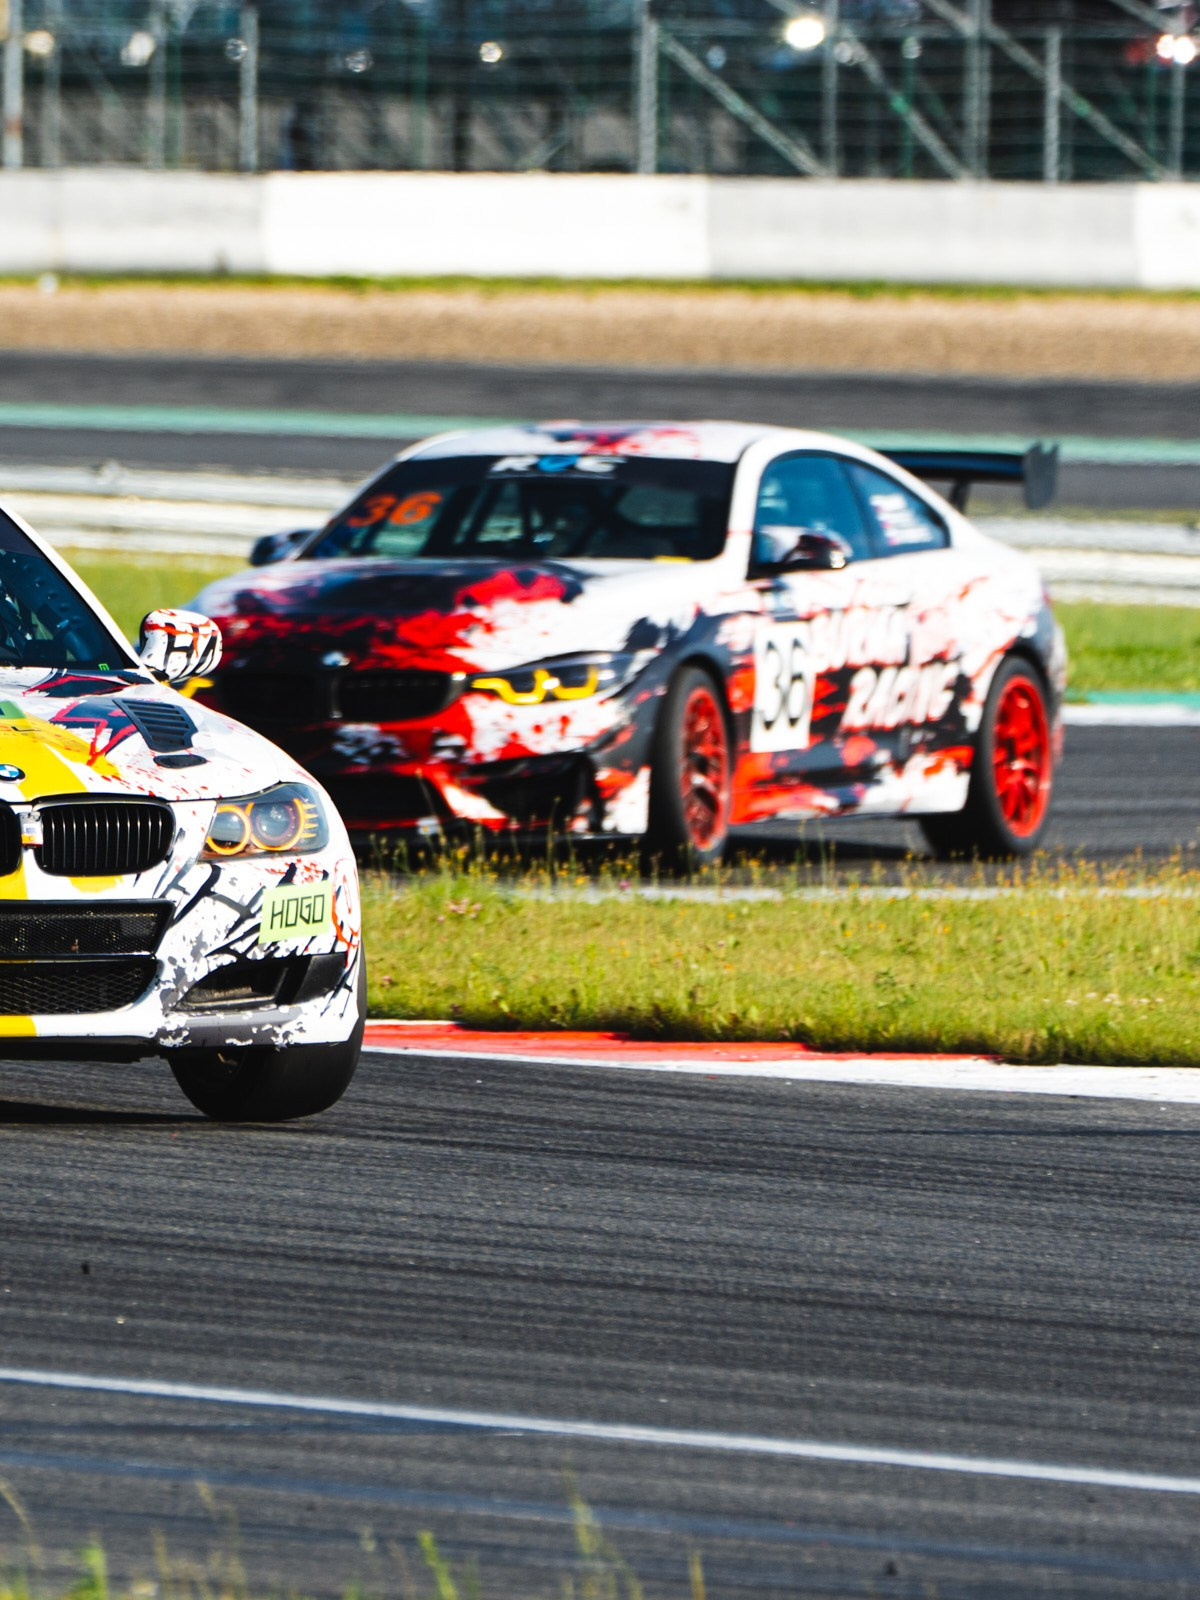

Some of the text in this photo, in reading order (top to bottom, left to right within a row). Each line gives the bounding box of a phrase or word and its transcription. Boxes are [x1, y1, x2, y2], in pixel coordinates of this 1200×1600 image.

[347, 491, 442, 527] 36
[762, 637, 810, 732] 36
[270, 894, 326, 930] HOGO
